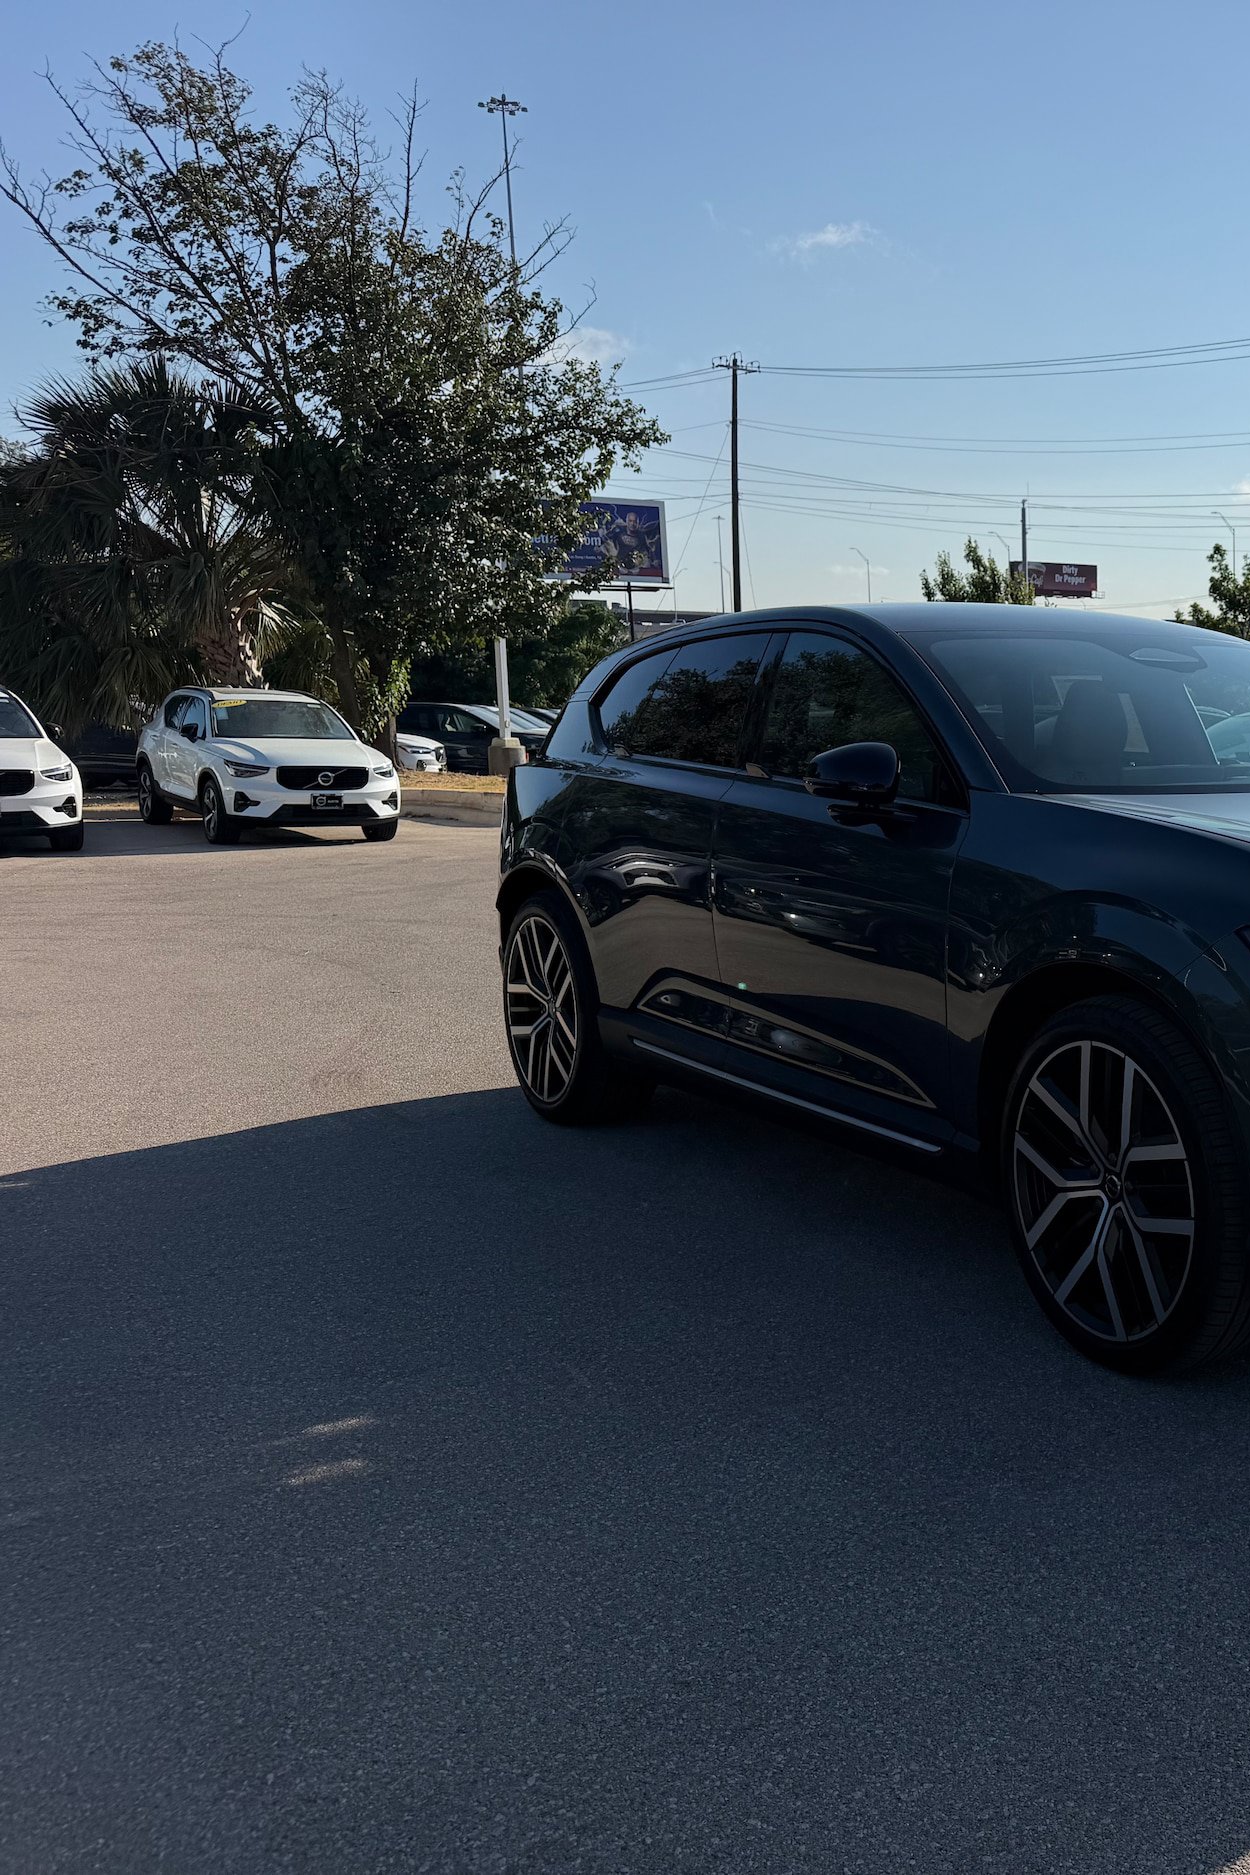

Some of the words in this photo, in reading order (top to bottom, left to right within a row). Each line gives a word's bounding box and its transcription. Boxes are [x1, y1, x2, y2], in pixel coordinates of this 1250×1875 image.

[1062, 565, 1079, 576] Dirty
[1055, 574, 1064, 583] Dr
[1064, 575, 1086, 586] Pepper
